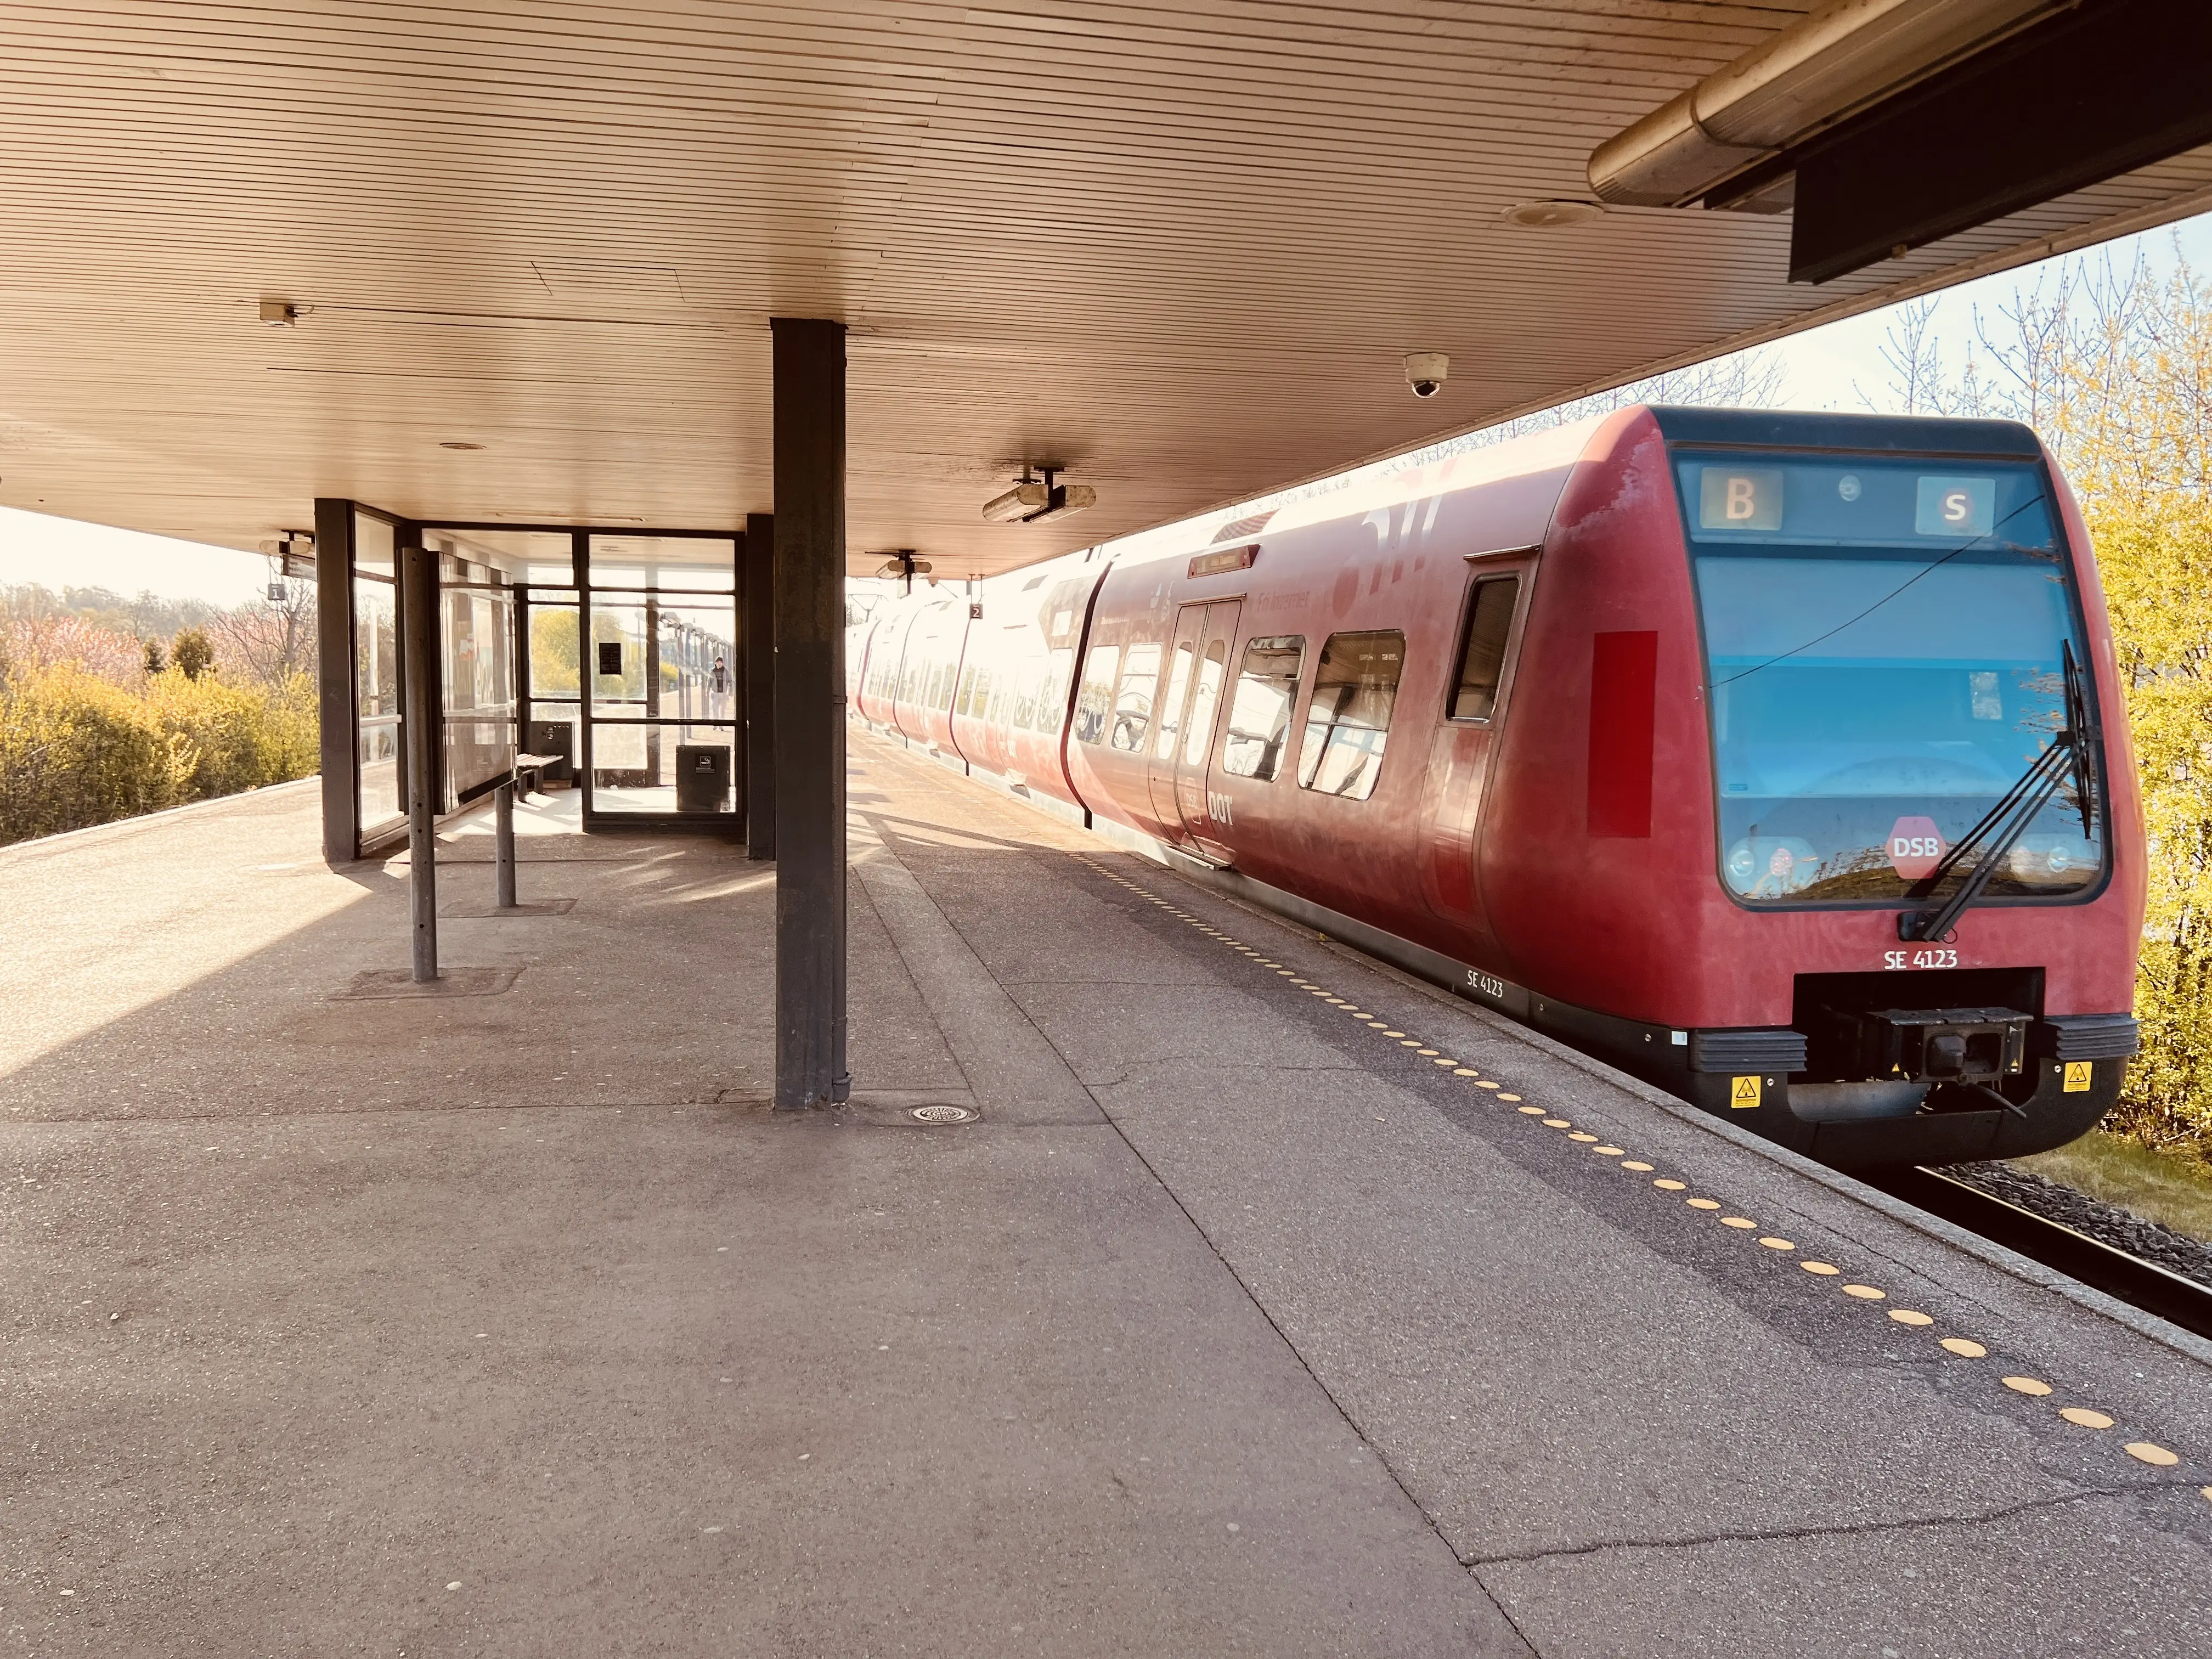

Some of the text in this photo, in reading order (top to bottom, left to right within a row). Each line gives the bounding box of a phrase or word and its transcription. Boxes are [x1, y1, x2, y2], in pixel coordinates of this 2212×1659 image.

[1726, 478, 1754, 519] B
[1945, 494, 1966, 521] S
[272, 589, 280, 599] 1
[973, 608, 980, 618] 2
[1894, 837, 1939, 857] DSB
[1884, 949, 1958, 969] SE 4123
[1467, 970, 1503, 998] SE 4123
